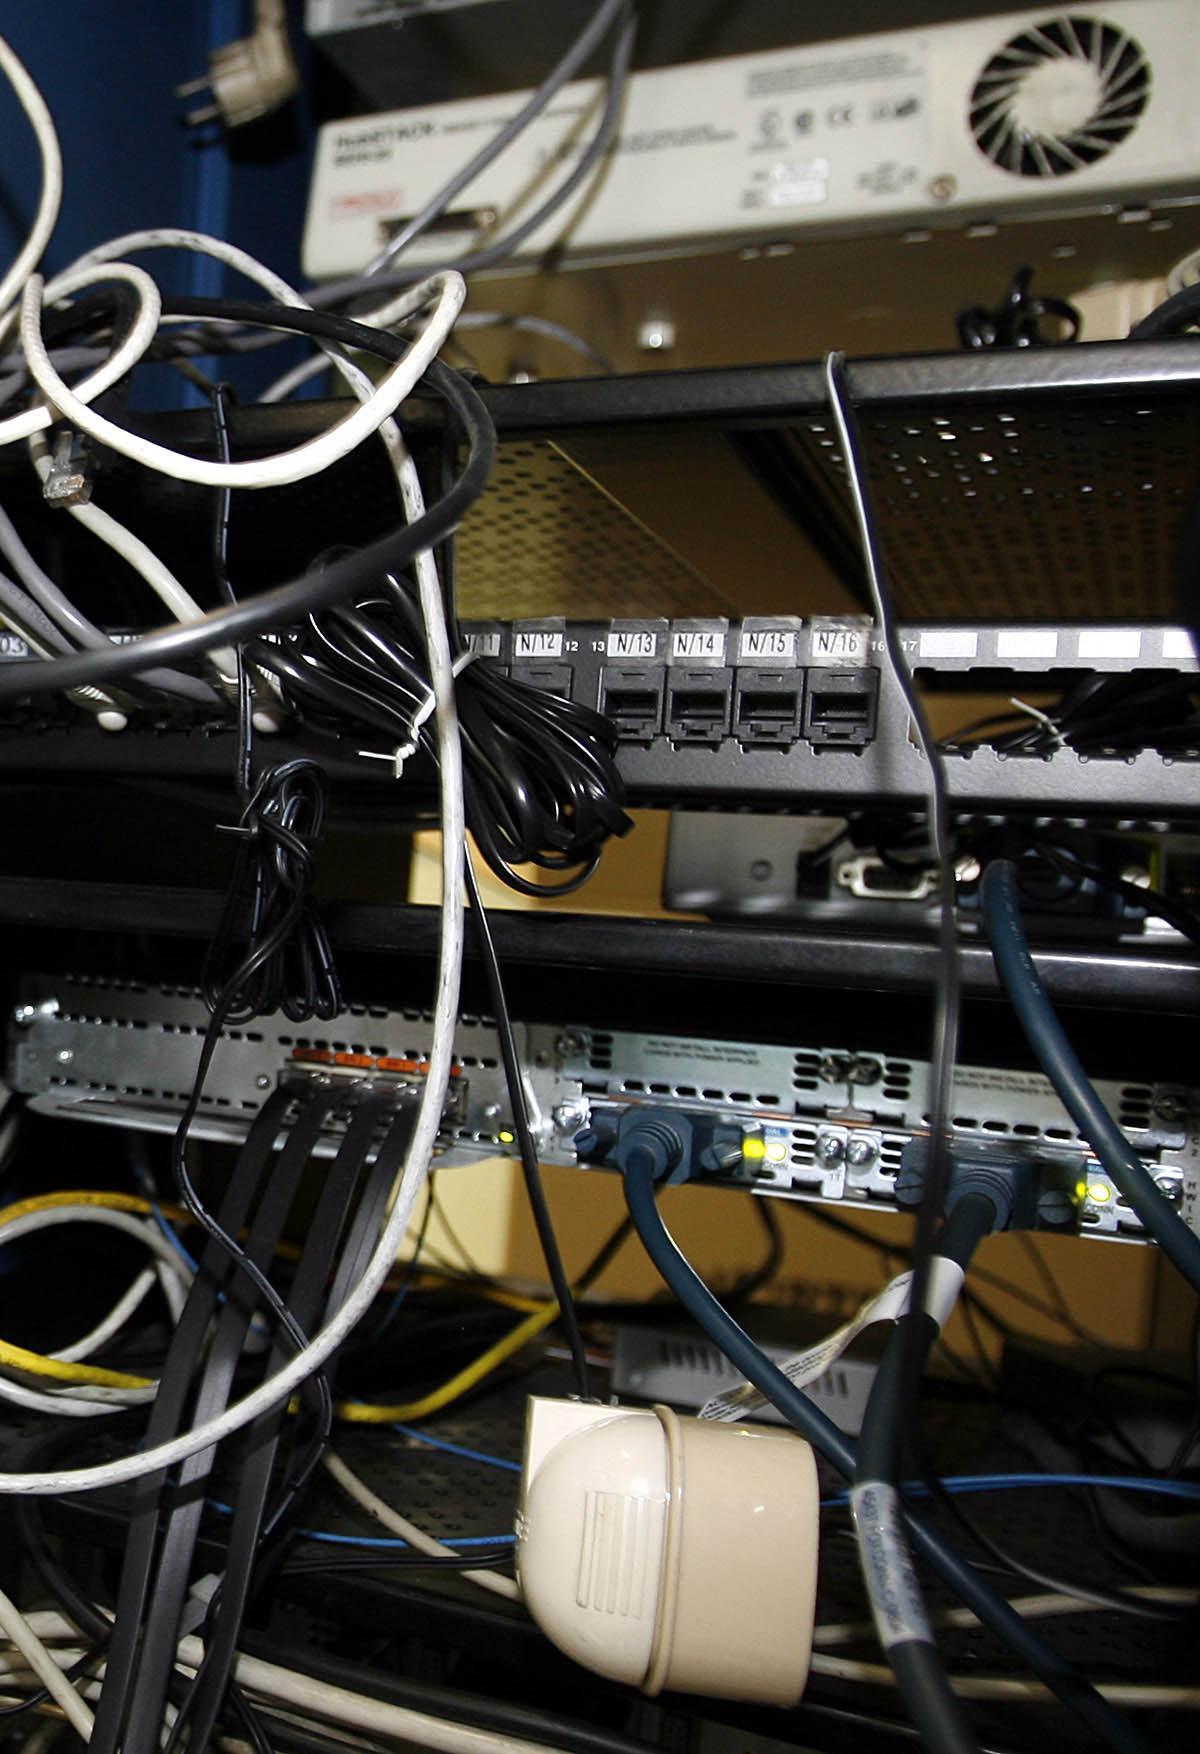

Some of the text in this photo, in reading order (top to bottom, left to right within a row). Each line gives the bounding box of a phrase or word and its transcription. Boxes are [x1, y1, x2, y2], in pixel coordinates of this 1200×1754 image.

[520, 634, 555, 652] N/12
[565, 641, 579, 652] 12
[592, 641, 605, 652] 13
[617, 634, 652, 654] N/13
[677, 634, 715, 654] N/14
[749, 634, 785, 653] N/15
[818, 633, 857, 652] N/16
[872, 641, 885, 652] 16
[902, 641, 917, 651] 17
